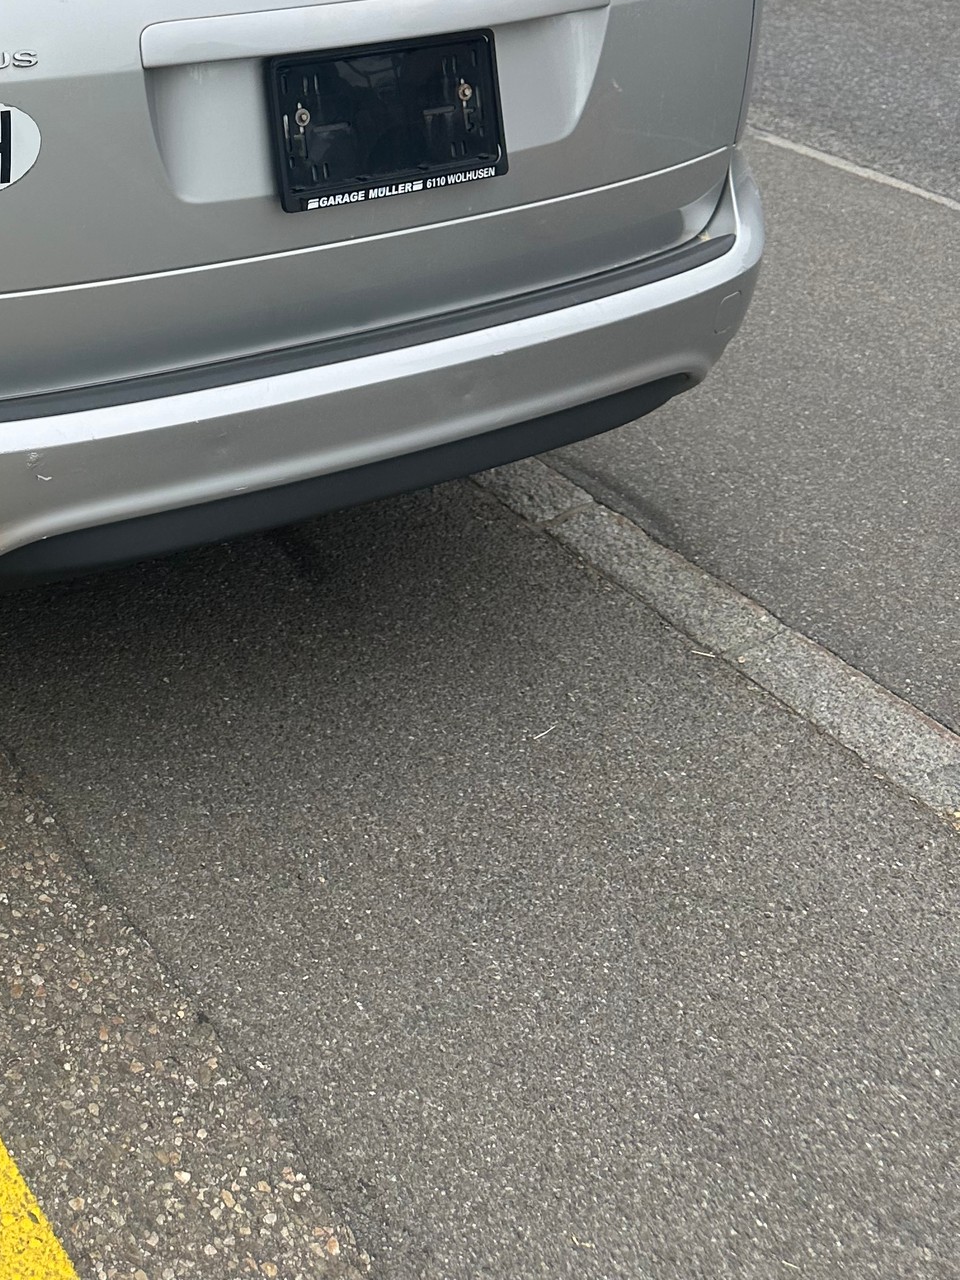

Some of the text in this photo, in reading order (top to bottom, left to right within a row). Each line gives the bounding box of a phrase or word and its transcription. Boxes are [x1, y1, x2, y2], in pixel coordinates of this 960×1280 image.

[320, 190, 365, 208] GARAGE
[426, 176, 446, 189] 6110
[447, 166, 496, 185] WOLHUSEN
